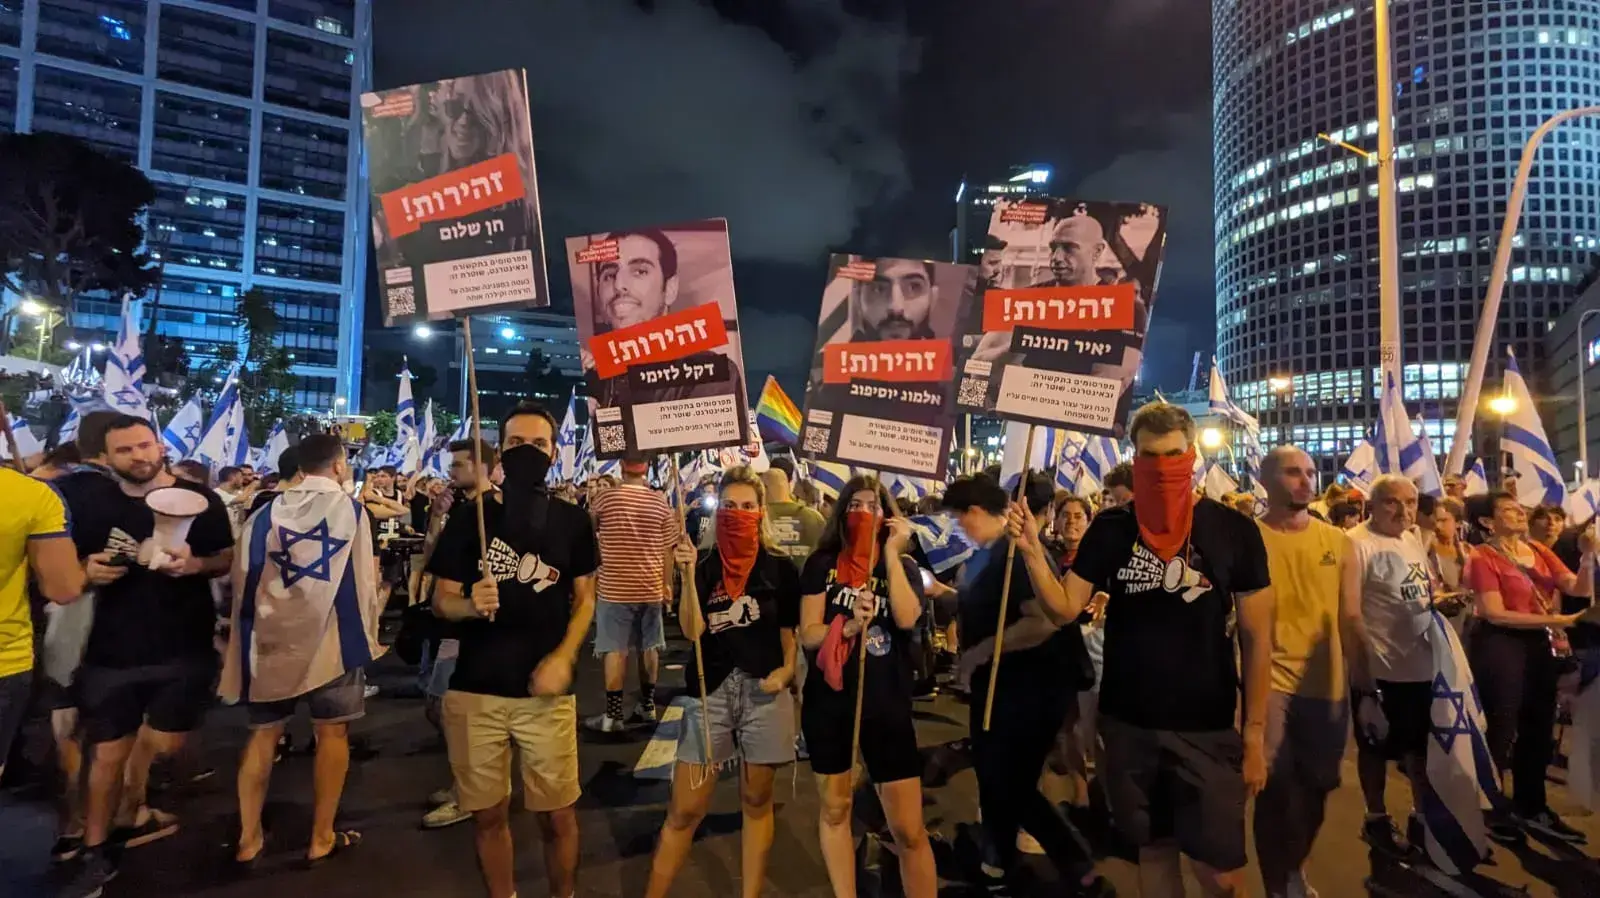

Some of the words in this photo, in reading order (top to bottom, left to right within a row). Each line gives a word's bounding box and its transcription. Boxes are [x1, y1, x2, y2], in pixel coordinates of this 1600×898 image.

[401, 171, 504, 222] זהירות!
[440, 221, 480, 240] שלום
[485, 218, 504, 236] חן
[452, 260, 488, 271] בתקשורת
[490, 255, 528, 265] מפרסומים
[460, 270, 485, 279] שוטרת
[1003, 297, 1115, 322] זהירות!
[608, 318, 708, 365] זהירות!
[1021, 334, 1069, 352] חנונה
[1074, 340, 1112, 356] יאיר
[840, 351, 936, 374] זהירות!
[640, 365, 680, 383] לזימי
[683, 362, 714, 380] דקל
[1033, 373, 1071, 385] בתקשורת
[1071, 379, 1115, 391] מפרסומים
[850, 383, 898, 400] יוסיפוב
[1044, 384, 1065, 392] שוטר
[696, 399, 731, 408] מפרסומים
[900, 390, 941, 406] אלמוג
[1021, 394, 1038, 402] ואיים
[1039, 397, 1060, 405] בפנים
[1062, 400, 1078, 408] עצור
[660, 403, 694, 412] בתקשורת
[1080, 403, 1093, 411] נער
[1095, 405, 1110, 413] הכה
[672, 412, 691, 420] שוטר
[1064, 410, 1094, 420] משפחתו
[684, 424, 703, 432] בפנים
[868, 422, 901, 433] בתקשורת
[879, 432, 897, 440] שוטר
[490, 536, 520, 562] רציתם
[486, 548, 519, 567] הפיכה
[1128, 556, 1164, 575] הפיכה
[1117, 568, 1162, 583] קיבלתם
[1125, 582, 1161, 594] מחאה
